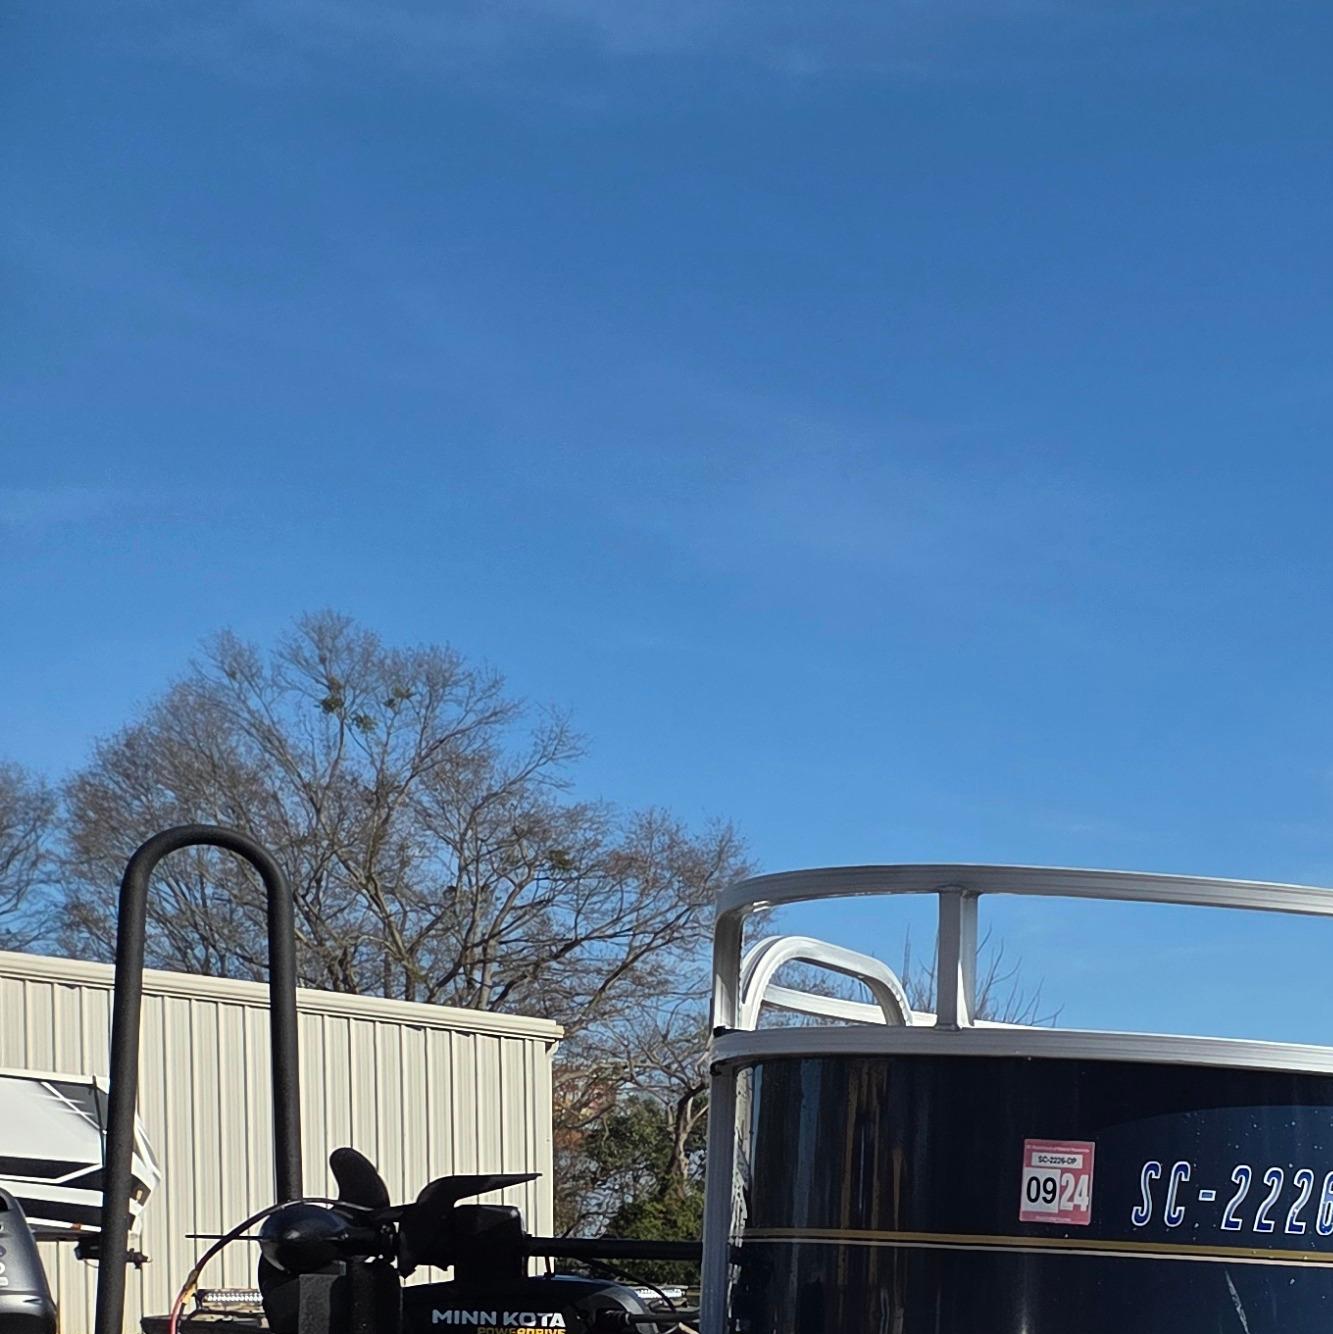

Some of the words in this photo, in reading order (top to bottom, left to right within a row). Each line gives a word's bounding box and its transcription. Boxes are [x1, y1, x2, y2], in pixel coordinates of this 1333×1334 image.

[1026, 1175, 1057, 1205] 09
[1060, 1172, 1090, 1212] 24
[431, 1308, 497, 1326] MINN
[502, 1310, 567, 1328] KOTA
